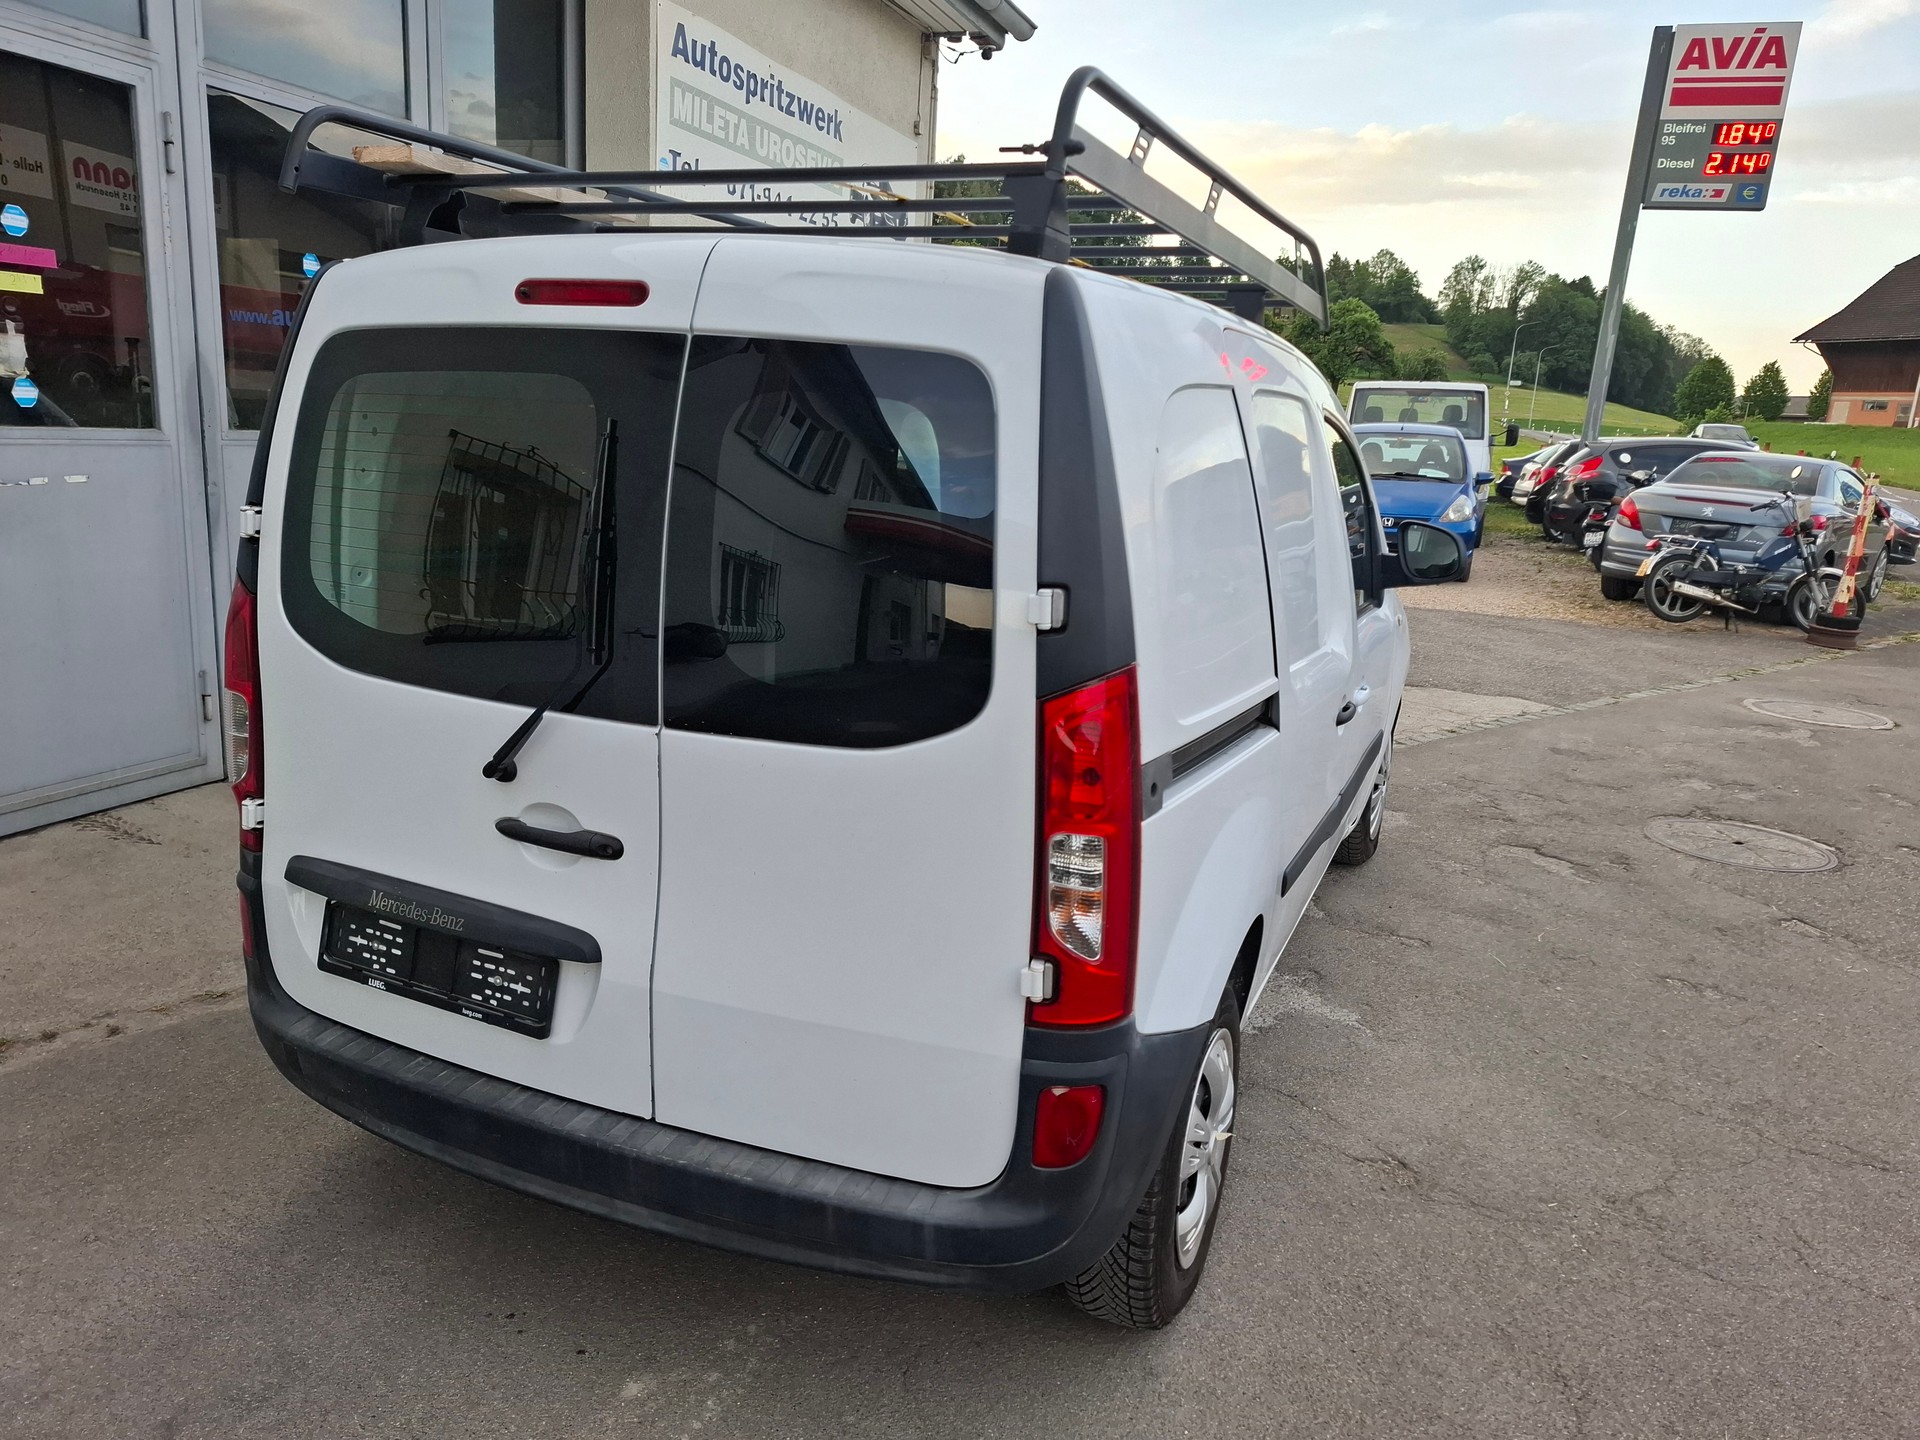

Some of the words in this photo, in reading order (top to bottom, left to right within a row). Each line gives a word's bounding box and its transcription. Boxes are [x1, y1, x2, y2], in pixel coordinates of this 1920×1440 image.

[671, 22, 843, 143] Autospritzwerk
[673, 85, 750, 150] MILETA
[756, 125, 841, 168] UROSEV
[1663, 123, 1707, 134] Bleifrei
[1661, 135, 1676, 146] 95
[1657, 158, 1695, 169] Diesel
[367, 889, 465, 932] Mercedes-Benz
[462, 1007, 483, 1019] lueg.com
